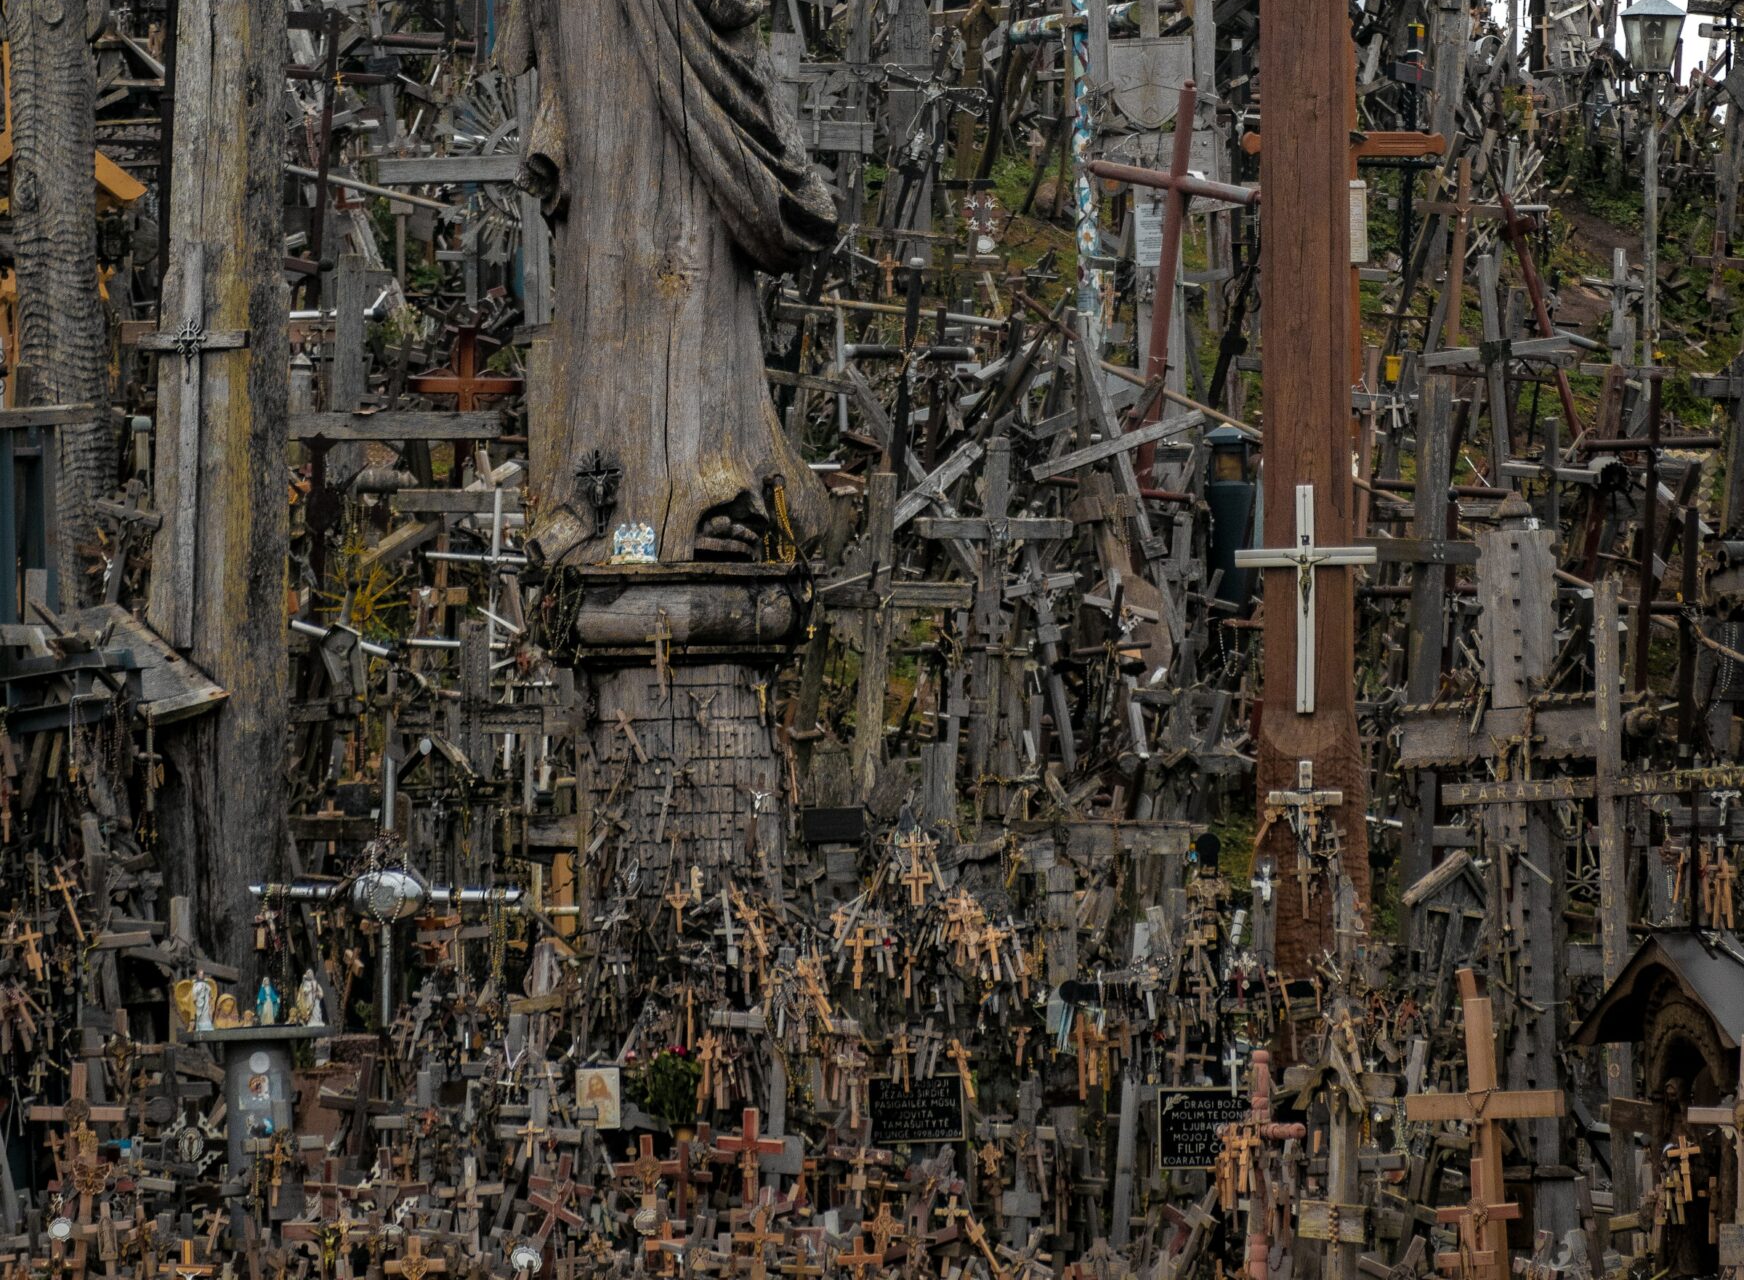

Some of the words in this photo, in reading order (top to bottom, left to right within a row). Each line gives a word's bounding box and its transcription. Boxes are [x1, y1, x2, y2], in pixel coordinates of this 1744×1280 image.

[1460, 781, 1575, 800] PARAFIA
[1184, 1100, 1214, 1110] DRAGI
[1217, 1099, 1242, 1110] BOŽE
[899, 1110, 934, 1120] JOVITA
[1171, 1111, 1205, 1120] MOLIM
[1207, 1110, 1219, 1120] TE
[1221, 1110, 1243, 1120] DON
[1173, 1133, 1208, 1142] MOJOJ
[1178, 1143, 1205, 1154] FILIP
[1209, 1142, 1226, 1154] ČO
[1163, 1155, 1212, 1166] KOARATIA
